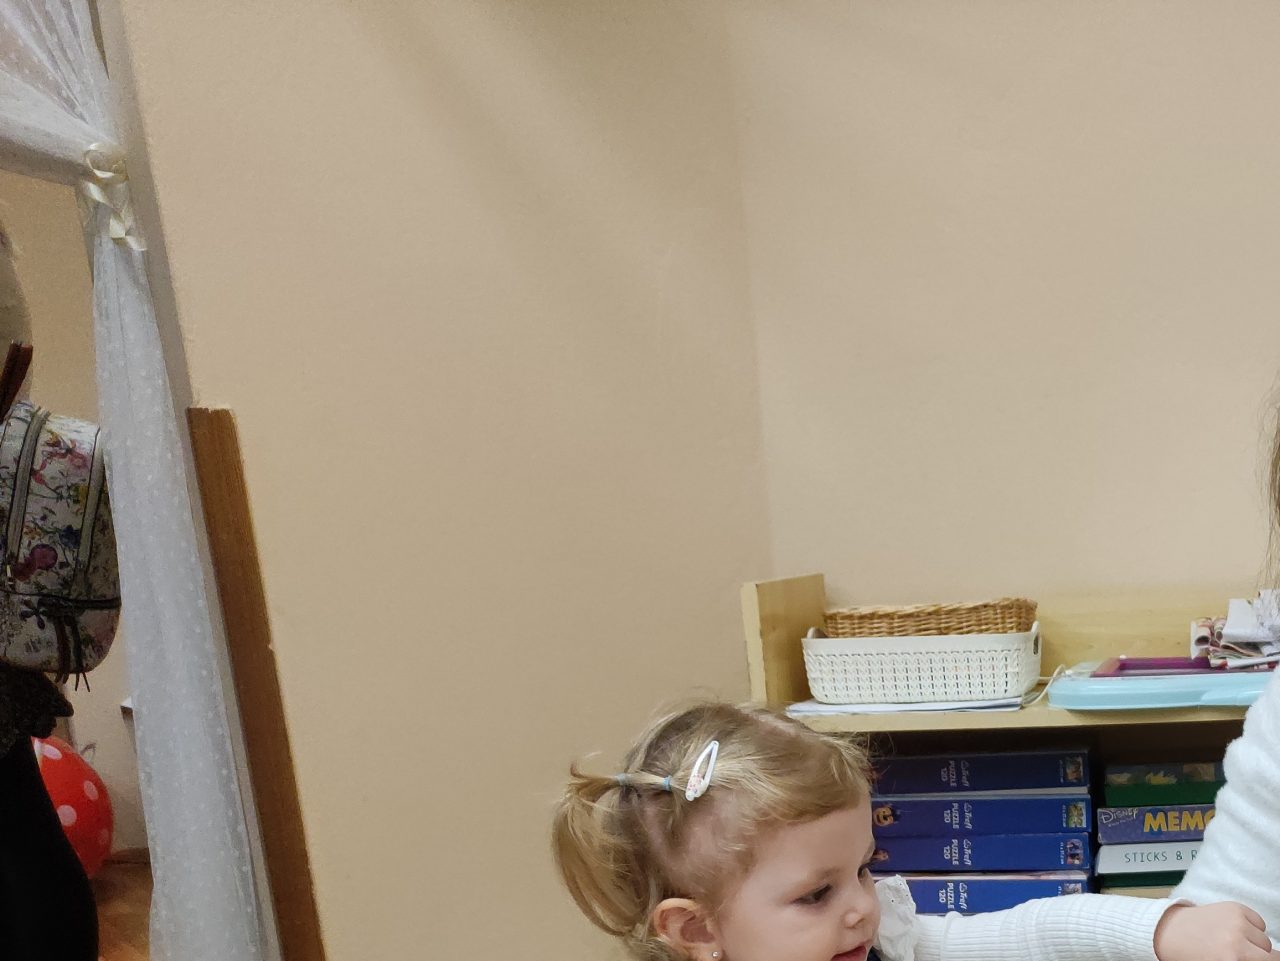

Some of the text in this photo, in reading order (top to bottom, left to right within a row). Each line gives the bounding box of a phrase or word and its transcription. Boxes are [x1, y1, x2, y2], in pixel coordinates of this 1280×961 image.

[940, 768, 948, 781] 120
[949, 760, 957, 787] PUZZLE
[943, 809, 951, 823] 120
[952, 802, 960, 829] PUZZLE
[943, 845, 951, 859] 120
[951, 839, 959, 865] PUZZLE
[1124, 851, 1168, 863] STICKS
[1175, 850, 1183, 861] &
[938, 889, 946, 903] 120
[946, 882, 954, 909] PUZZLE
